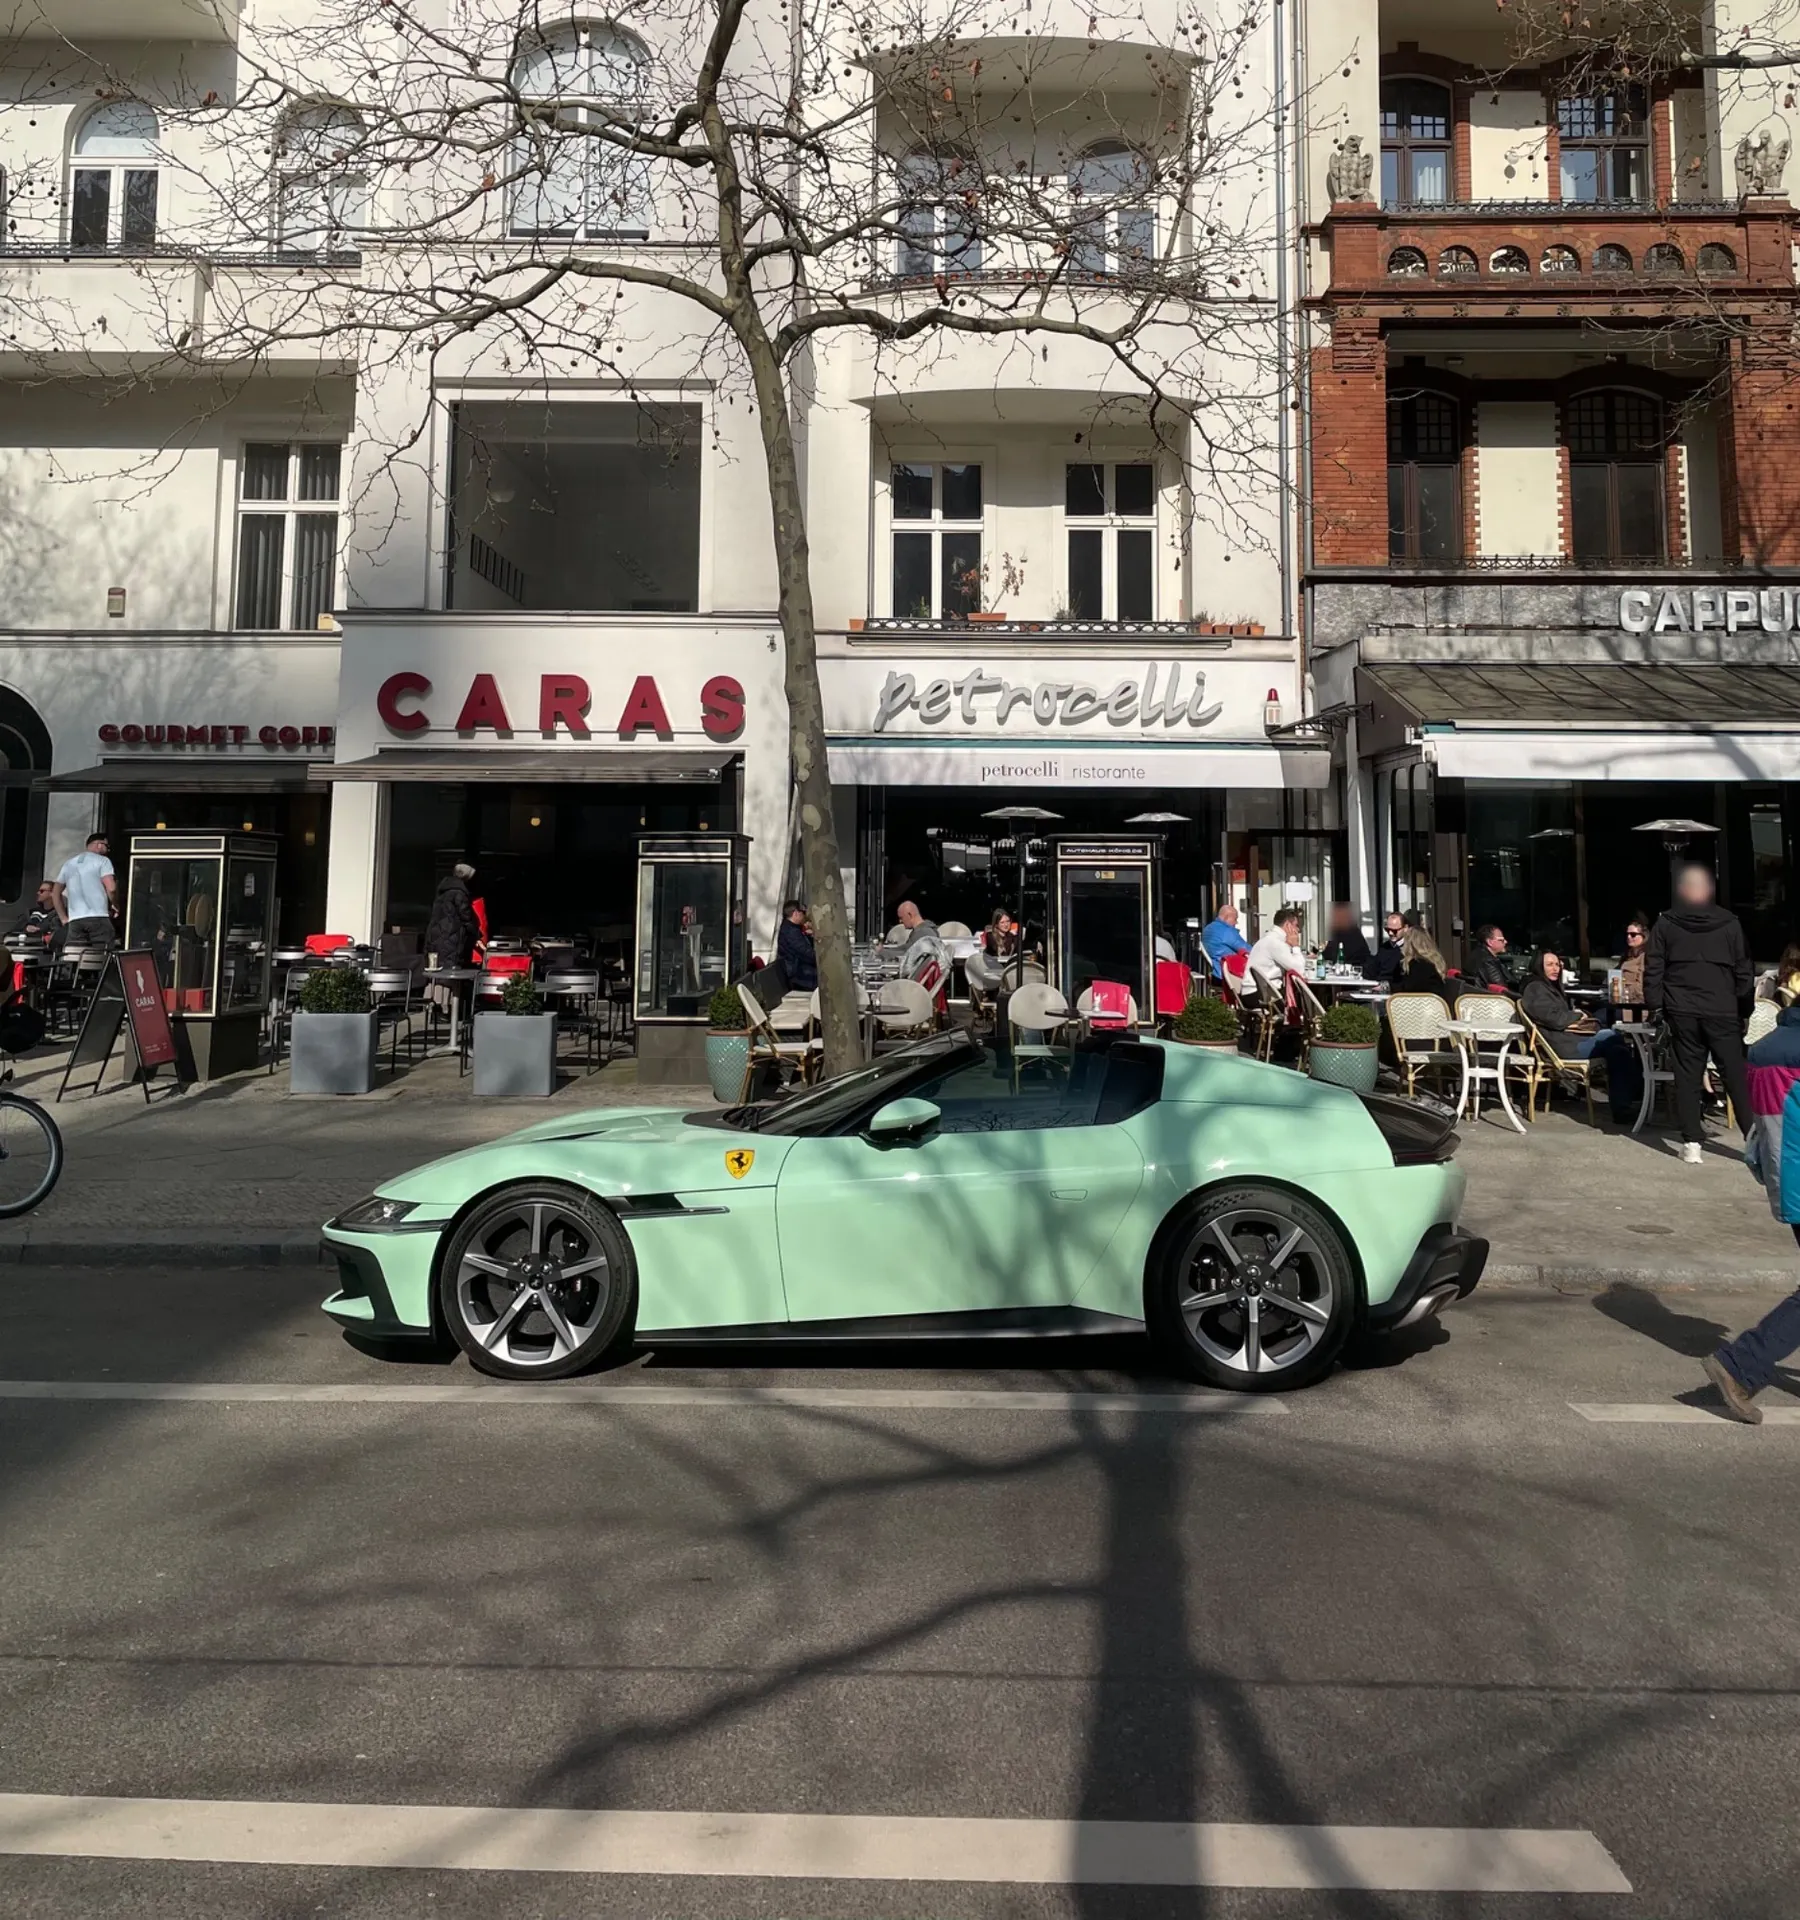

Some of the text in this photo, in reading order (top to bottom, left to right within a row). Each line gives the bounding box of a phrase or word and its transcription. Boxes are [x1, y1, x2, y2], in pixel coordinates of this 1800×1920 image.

[1619, 590, 1800, 632] CAPPU
[376, 671, 746, 734] CARAS
[873, 661, 1223, 732] petrocelli
[98, 724, 337, 745] GOURMET COFF
[982, 761, 1146, 781] petrocelli ristorante
